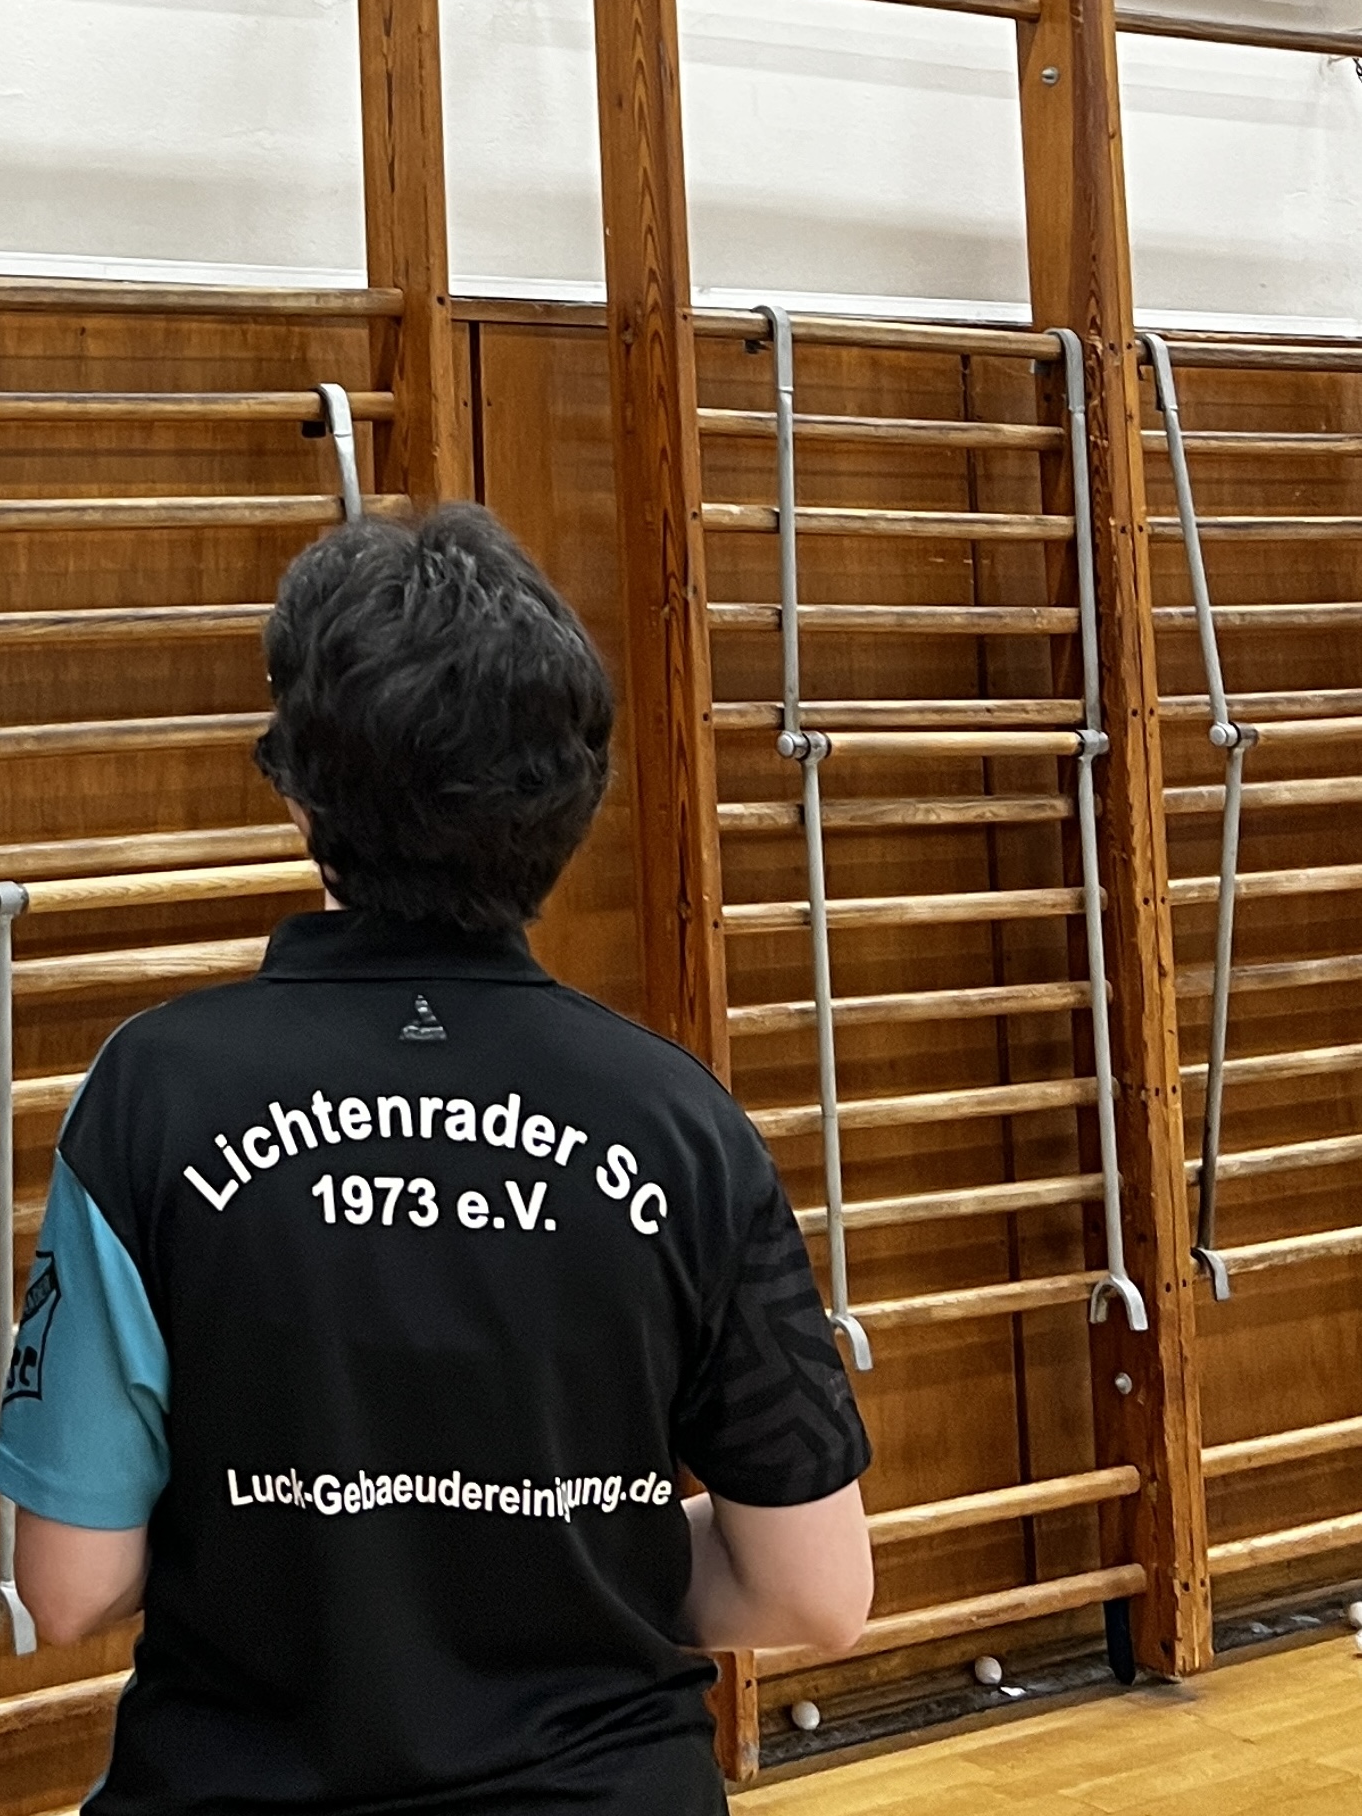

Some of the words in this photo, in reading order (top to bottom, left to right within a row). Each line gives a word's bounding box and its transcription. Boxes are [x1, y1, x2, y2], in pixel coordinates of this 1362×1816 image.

[183, 1090, 587, 1211] Lichtenrader
[595, 1144, 668, 1234] SC
[312, 1174, 438, 1226] 1973
[456, 1180, 556, 1232] e.V.
